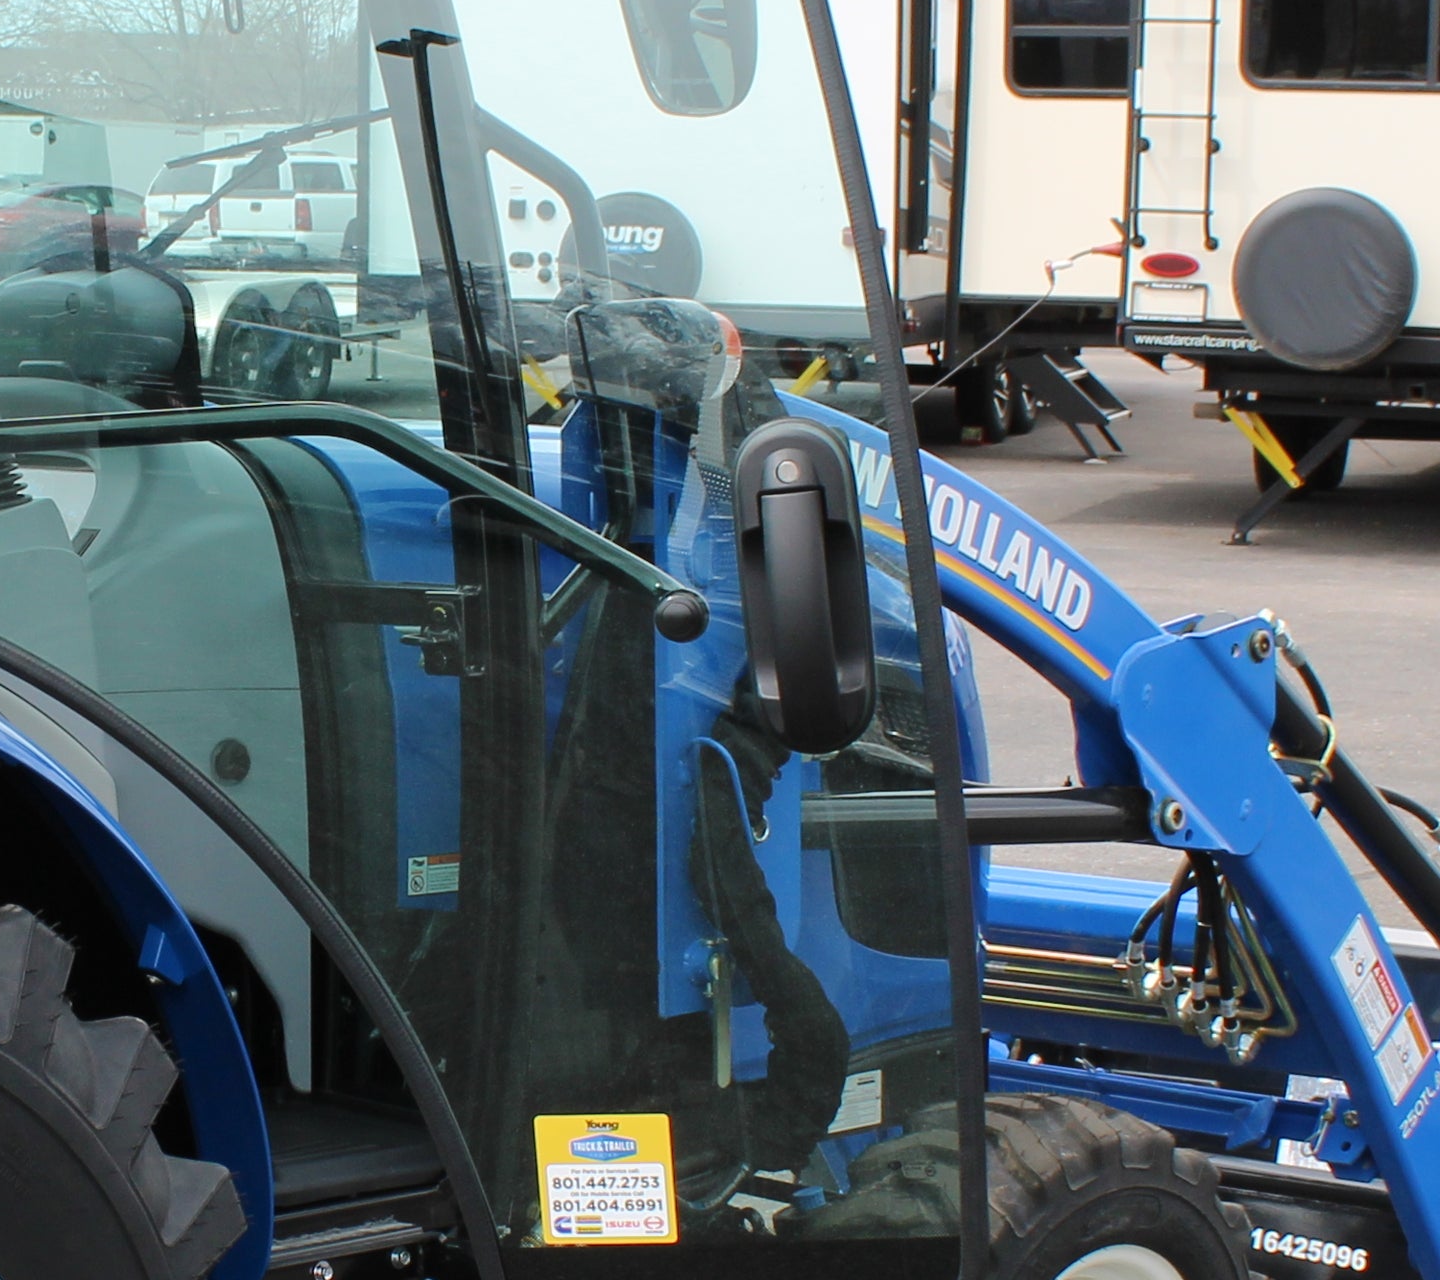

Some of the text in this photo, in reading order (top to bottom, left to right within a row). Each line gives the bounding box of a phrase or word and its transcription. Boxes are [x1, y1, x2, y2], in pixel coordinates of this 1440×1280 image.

[603, 225, 664, 253] ung
[1133, 333, 1263, 352] www.starcraftcamping.
[585, 1120, 620, 1131] Young
[573, 1141, 596, 1152] TRUCK
[604, 1140, 635, 1152] TRAILER
[552, 1176, 660, 1190] 801.447.2753
[552, 1199, 664, 1213] 801.404.6991
[605, 1220, 640, 1228] ISUZU
[1250, 1227, 1369, 1272] 16425096
